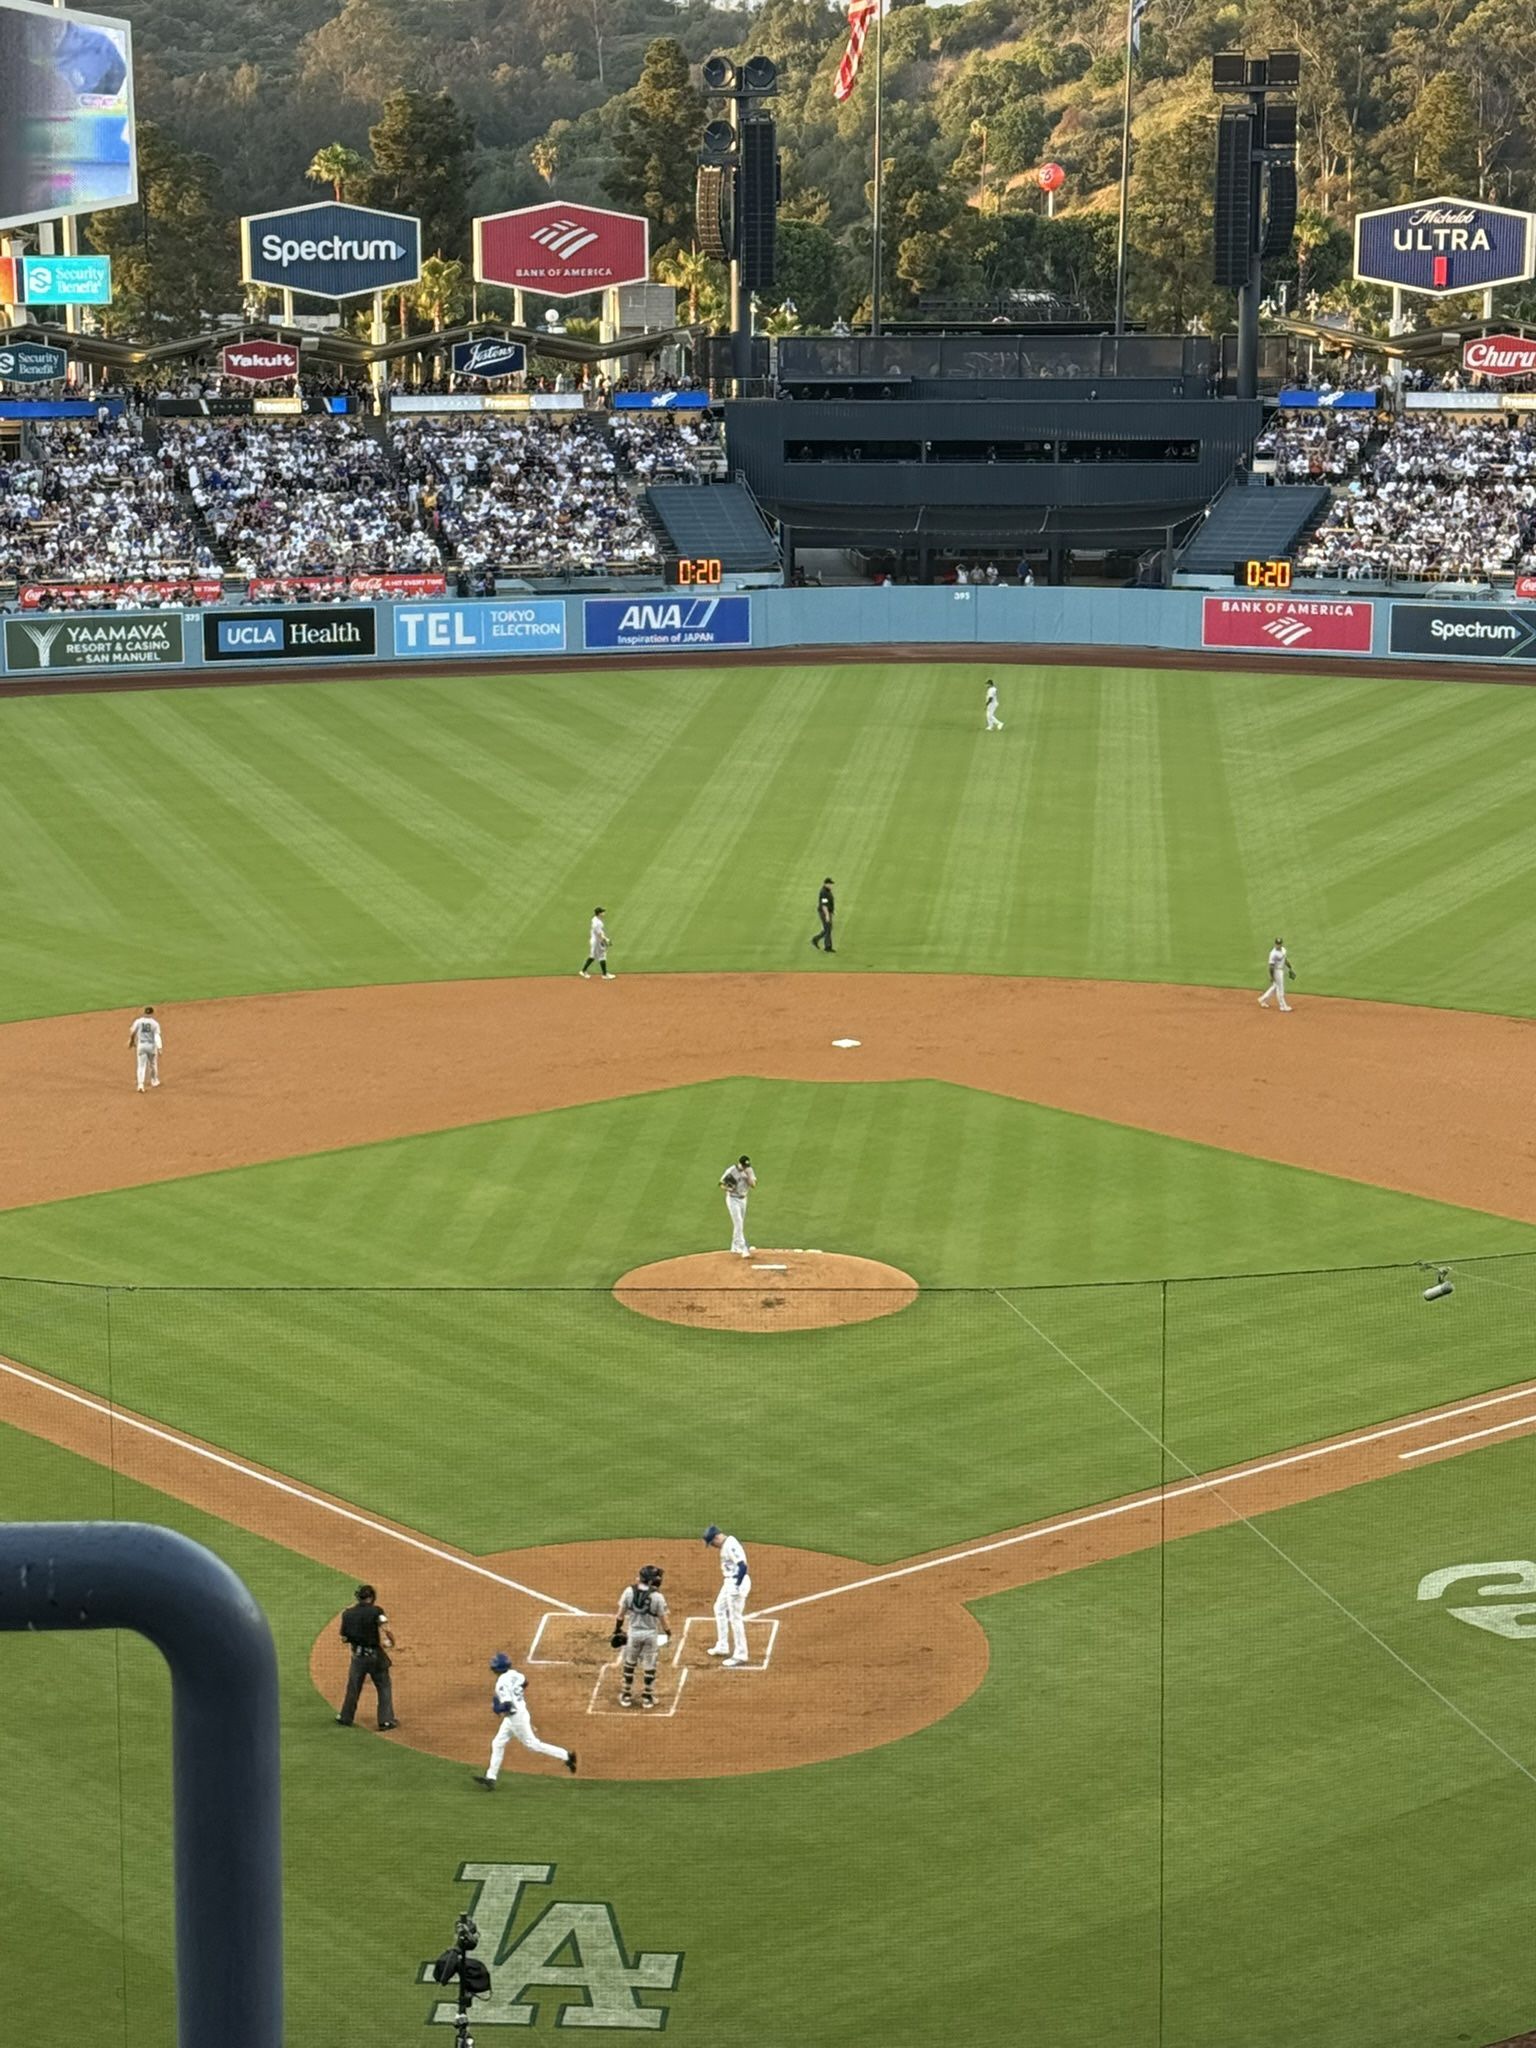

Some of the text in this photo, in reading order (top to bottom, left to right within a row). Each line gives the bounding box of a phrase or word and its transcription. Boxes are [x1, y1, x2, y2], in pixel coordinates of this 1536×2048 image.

[1409, 208, 1476, 226] Michelob
[1394, 228, 1490, 251] ULTRA
[262, 235, 397, 267] Spectrum
[55, 267, 105, 281] Security
[516, 268, 613, 277] BANK OF AMERICA
[57, 281, 100, 294] Benefit
[18, 352, 59, 363] Security
[228, 354, 295, 368] Yakult
[1466, 344, 1536, 368] Churu
[20, 363, 54, 375] Benefit
[679, 559, 721, 584] 0:20
[1247, 561, 1291, 587] 0:20
[490, 609, 535, 622] TOKYO
[618, 604, 681, 630] ANA
[1222, 601, 1354, 617] BANK OF AMERICA
[227, 627, 276, 645] UCLA
[289, 622, 361, 644] Health
[400, 611, 476, 647] TEL
[492, 622, 560, 637] ELECTRON
[1431, 619, 1516, 641] Spectrum
[66, 640, 170, 654] RESORT & CASINO
[617, 632, 714, 645] Inspiration of JAPAN
[85, 654, 109, 664] SAN
[112, 651, 161, 663] MANUEL
[415, 1861, 685, 2031] LA
